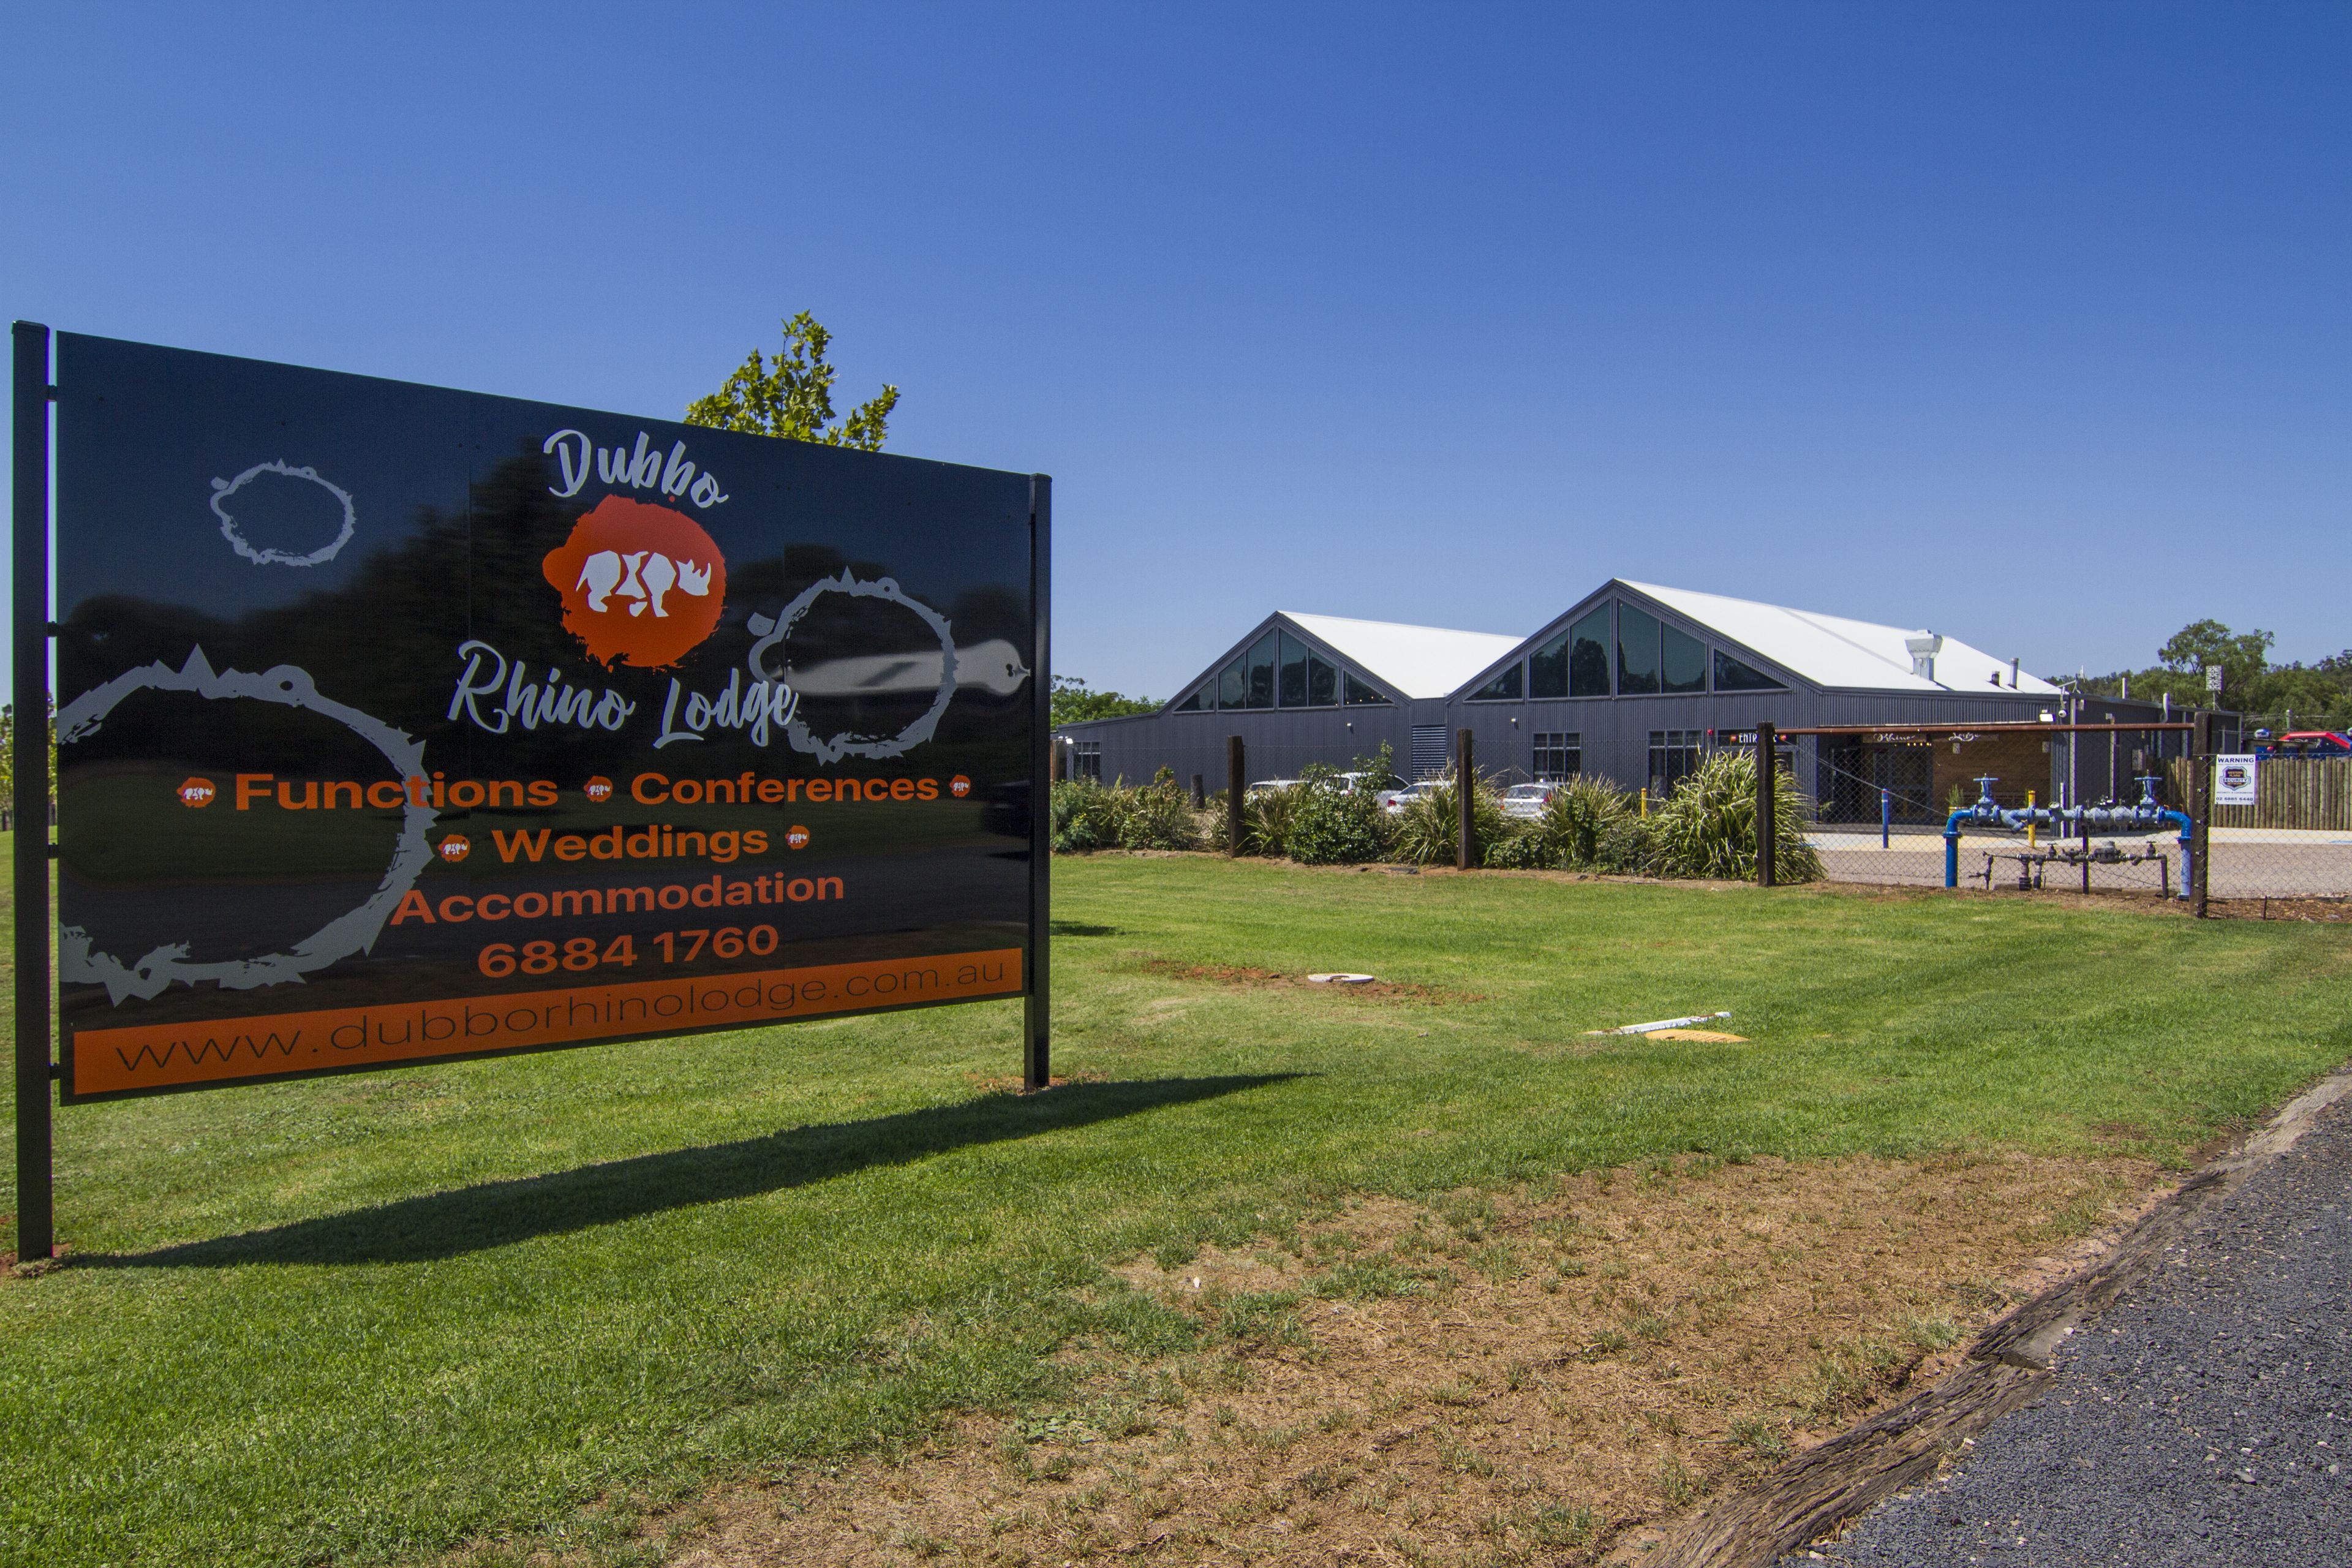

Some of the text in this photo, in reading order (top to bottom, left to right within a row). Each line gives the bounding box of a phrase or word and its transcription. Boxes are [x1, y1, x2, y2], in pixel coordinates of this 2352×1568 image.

[543, 429, 729, 508] Dubbo
[447, 640, 799, 749] Rhino Lodge
[1738, 733, 1777, 743] ENTRE
[236, 772, 938, 810] Functions Conferences
[492, 824, 768, 863] Weddings
[390, 872, 844, 925] Accommodation
[478, 925, 778, 978] 6884 1760
[116, 962, 1003, 1071] www.dubborhinolodge.com.au
